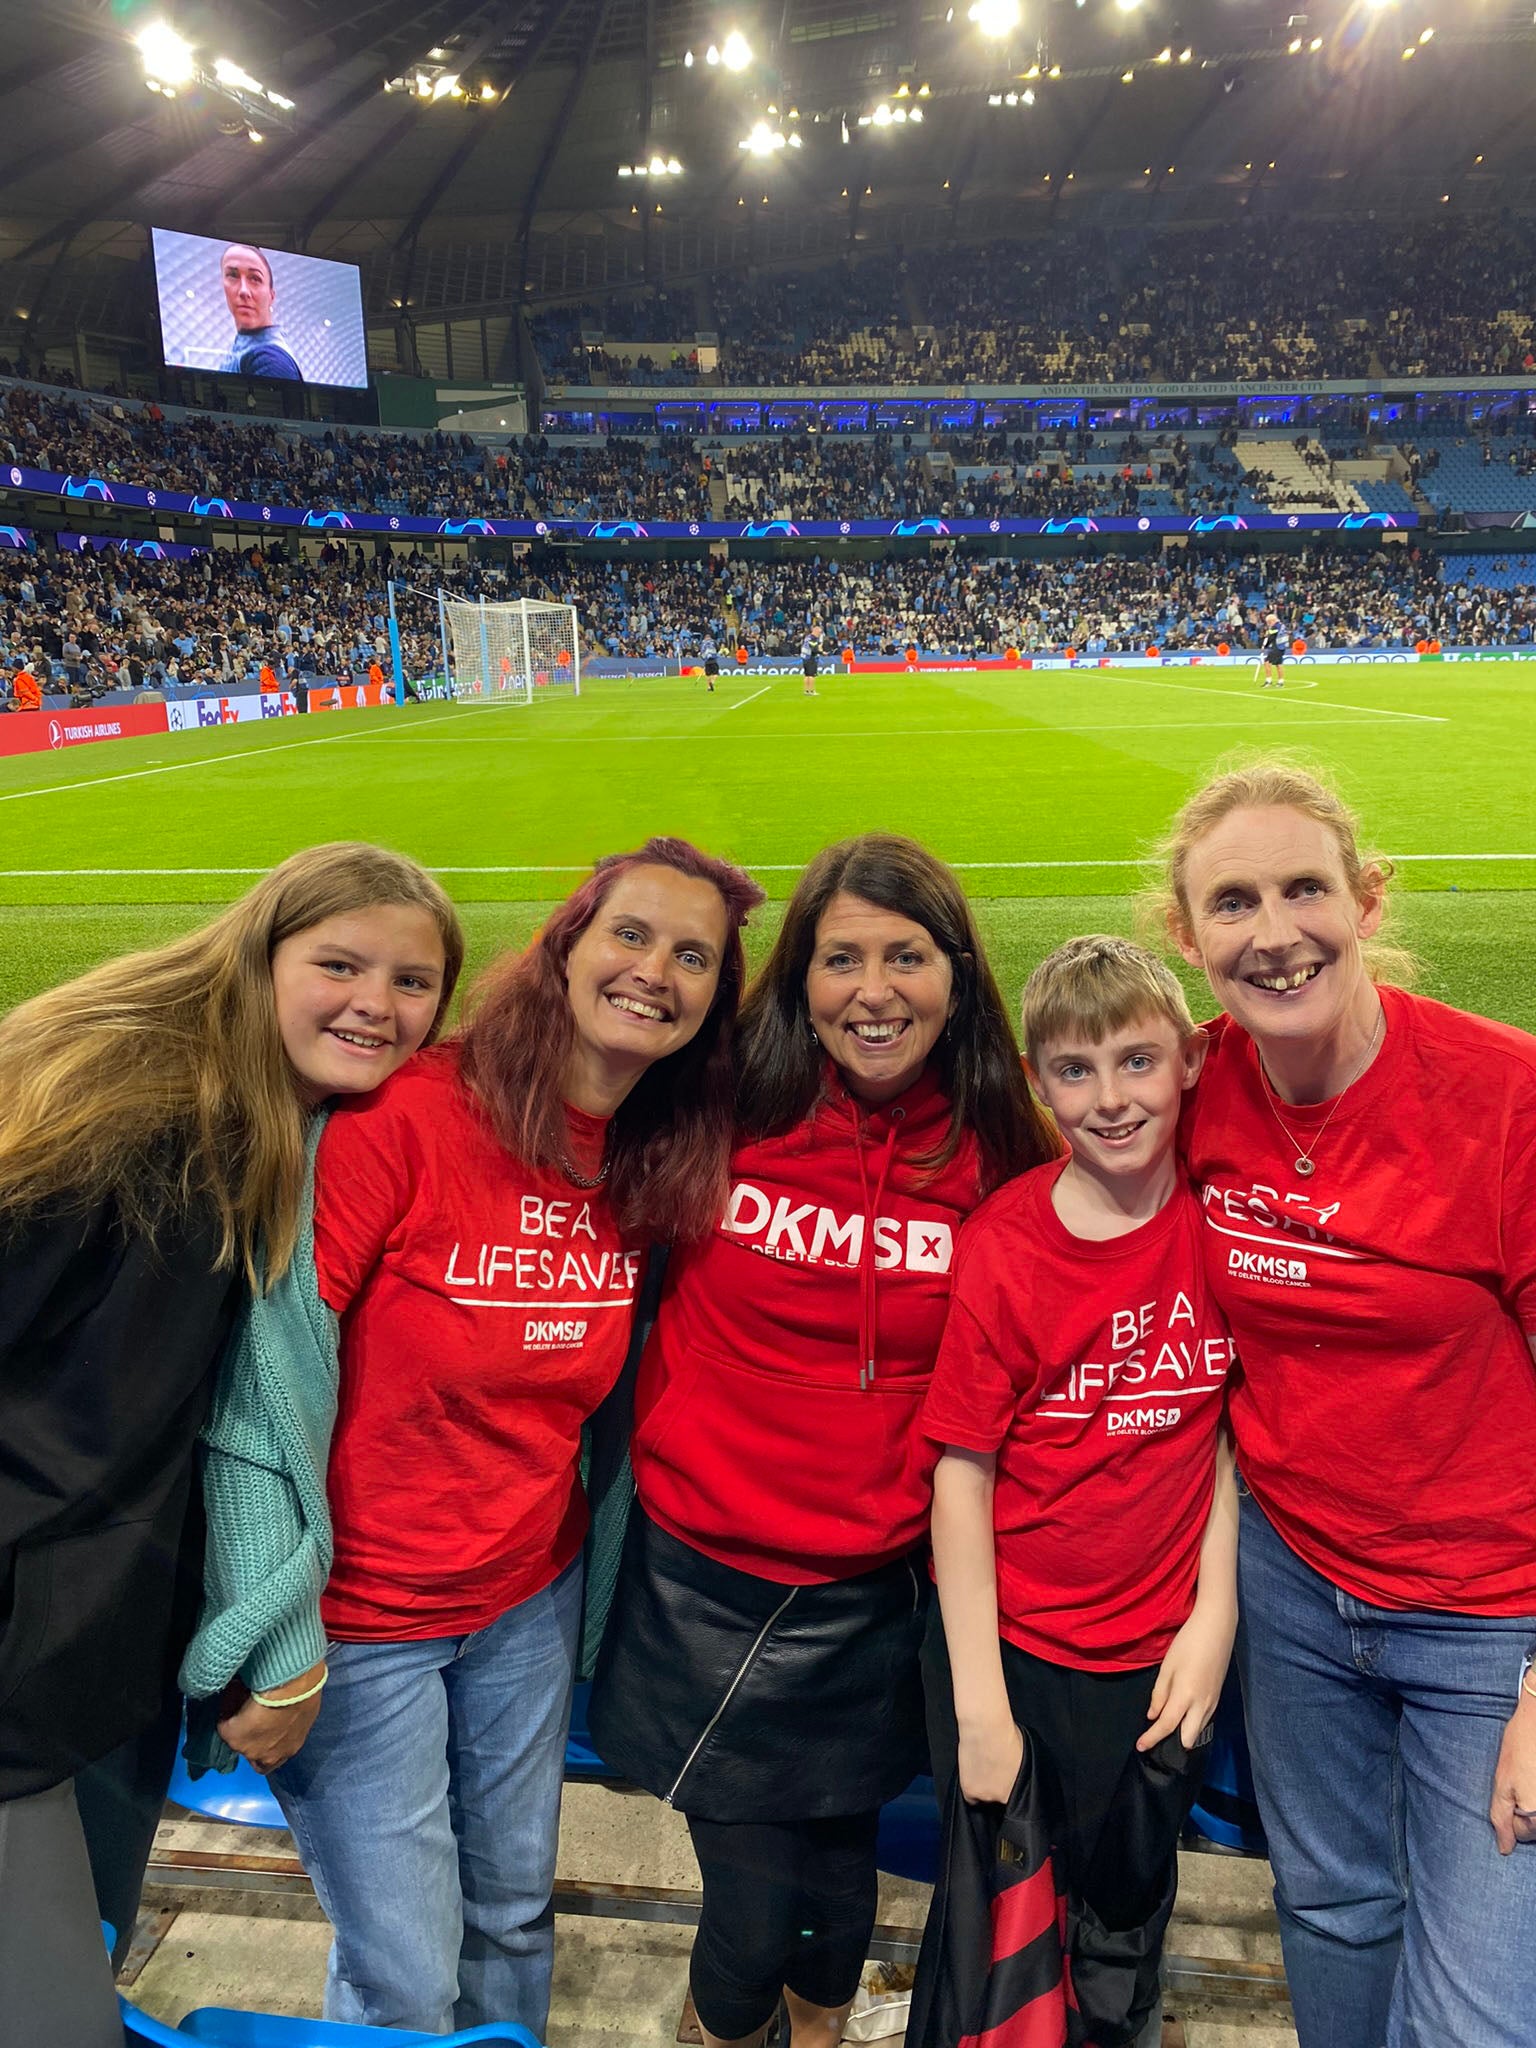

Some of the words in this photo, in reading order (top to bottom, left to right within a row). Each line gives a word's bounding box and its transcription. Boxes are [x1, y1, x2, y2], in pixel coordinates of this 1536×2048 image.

[1040, 387, 1062, 395] AND
[1063, 386, 1079, 395] ON
[1080, 385, 1099, 395] THE
[1102, 385, 1133, 394] SIXTH
[1135, 384, 1154, 394] DAY
[1156, 384, 1179, 393] GOD
[1180, 383, 1228, 393] CREATED
[1230, 382, 1298, 393] MANCHESTER
[1300, 381, 1323, 391] CITY
[718, 664, 835, 676] mastercd
[64, 725, 94, 740] TURKISH
[94, 722, 122, 737] AIRLINES
[520, 1195, 571, 1239] BE
[570, 1202, 597, 1241] A
[719, 1182, 904, 1269] DKMS
[1228, 1248, 1288, 1278] DKMS
[1227, 1269, 1238, 1277] WE
[1238, 1271, 1262, 1282] DELETE
[1262, 1276, 1285, 1286] BLOOD
[524, 1320, 575, 1342] DKMS
[1111, 1300, 1157, 1350] BE
[1168, 1290, 1195, 1329] A
[1107, 1408, 1167, 1431] DKMS
